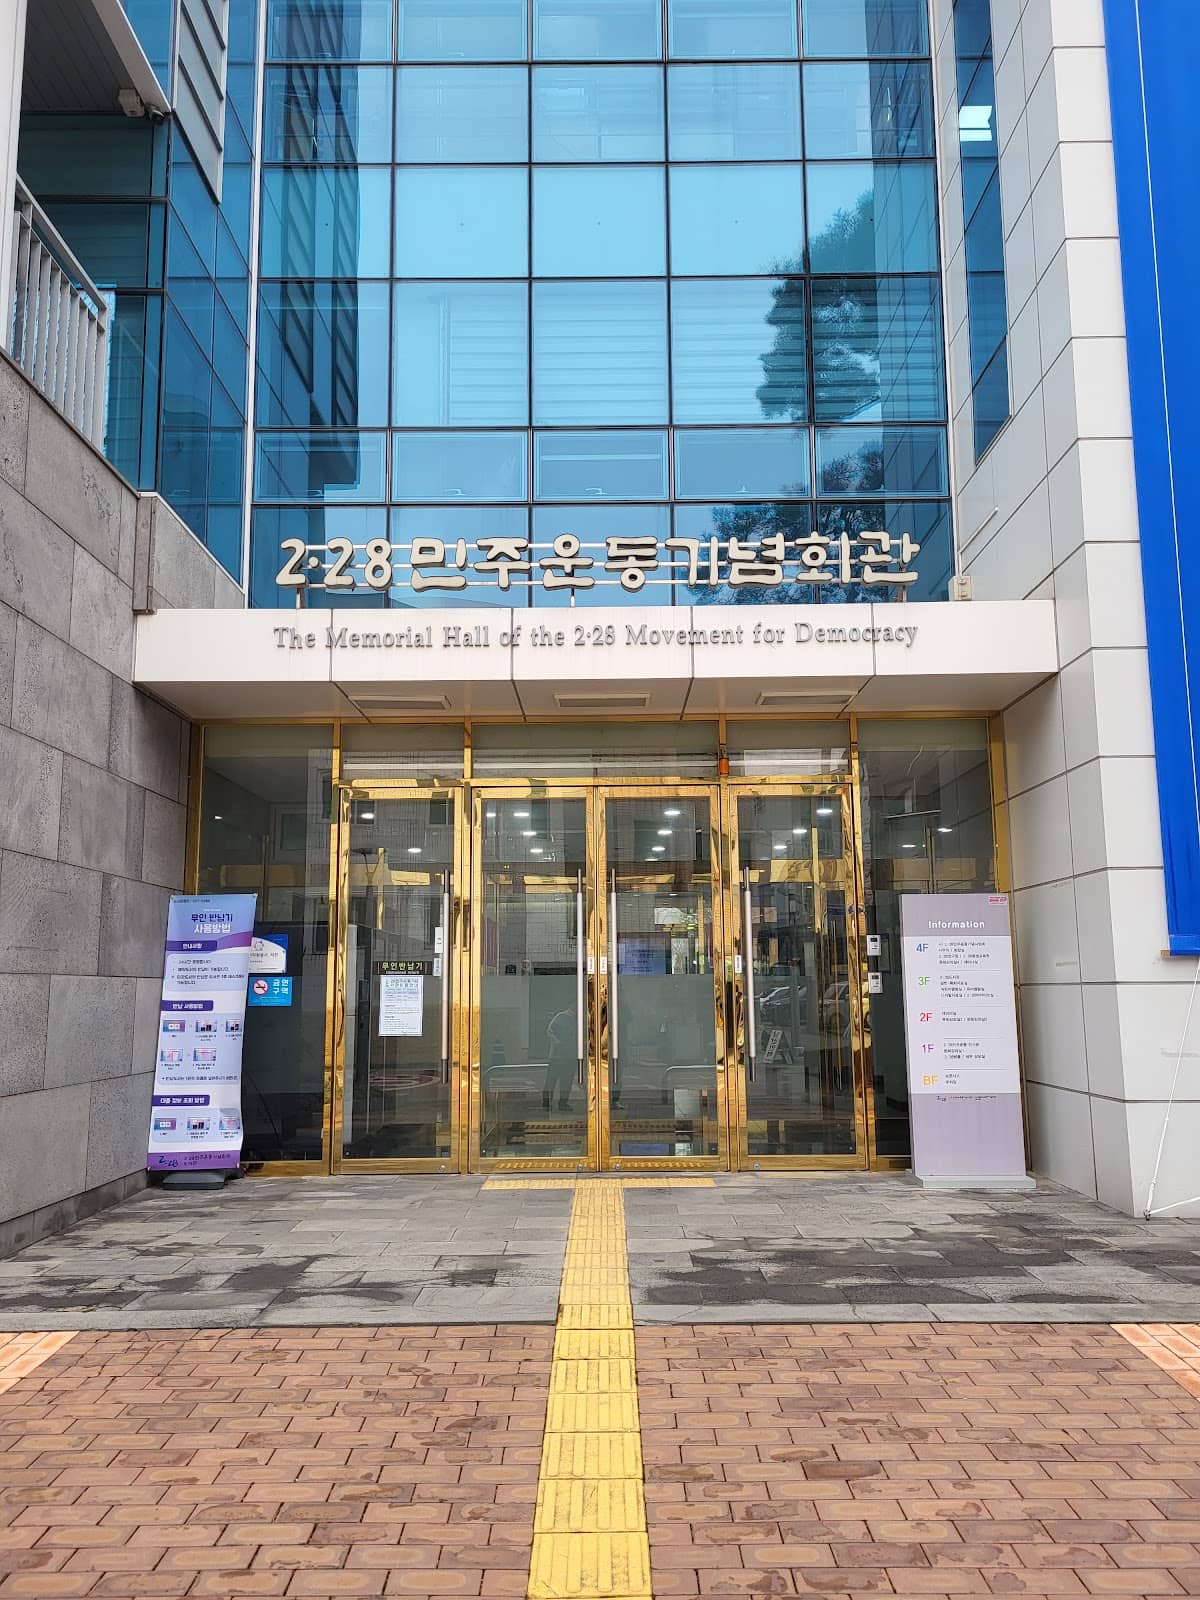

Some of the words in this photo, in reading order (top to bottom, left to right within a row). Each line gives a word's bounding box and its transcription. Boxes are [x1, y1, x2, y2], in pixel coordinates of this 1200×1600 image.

[273, 626, 316, 649] The
[325, 625, 433, 649] Memorial
[443, 625, 491, 648] Hall
[499, 625, 522, 648] of
[530, 625, 565, 647] the
[625, 624, 744, 646] Movement
[753, 622, 785, 645] for
[795, 622, 918, 648] Democracy
[928, 920, 985, 929] Information
[916, 943, 929, 953] 4F
[918, 976, 931, 986] 3F
[920, 1012, 933, 1022] 2F
[922, 1044, 935, 1054] 1F
